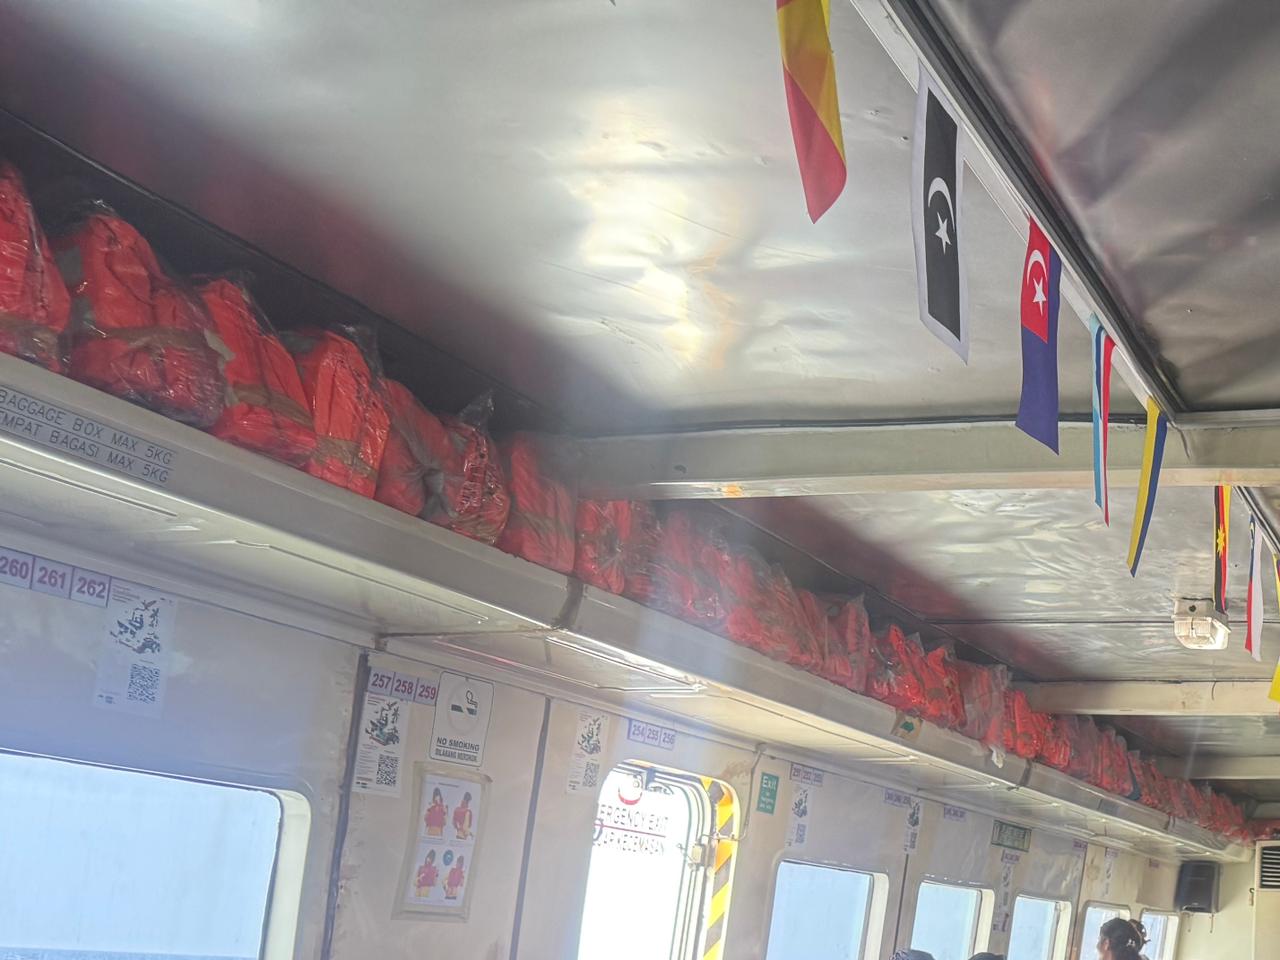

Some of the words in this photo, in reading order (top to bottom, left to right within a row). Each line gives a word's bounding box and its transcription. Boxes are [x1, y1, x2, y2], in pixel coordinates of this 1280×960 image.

[49, 430, 99, 458] BAGASI
[107, 451, 135, 471] MAX
[142, 464, 169, 483] 5KG
[72, 417, 104, 439] BOX
[111, 432, 139, 452] MAX
[146, 446, 173, 465] 5KG
[0, 556, 29, 580] 260
[37, 566, 66, 590] 261
[76, 576, 106, 599] 262
[371, 673, 392, 690] 257
[394, 679, 414, 695] 258
[418, 684, 437, 700] 259
[437, 736, 447, 746] NO
